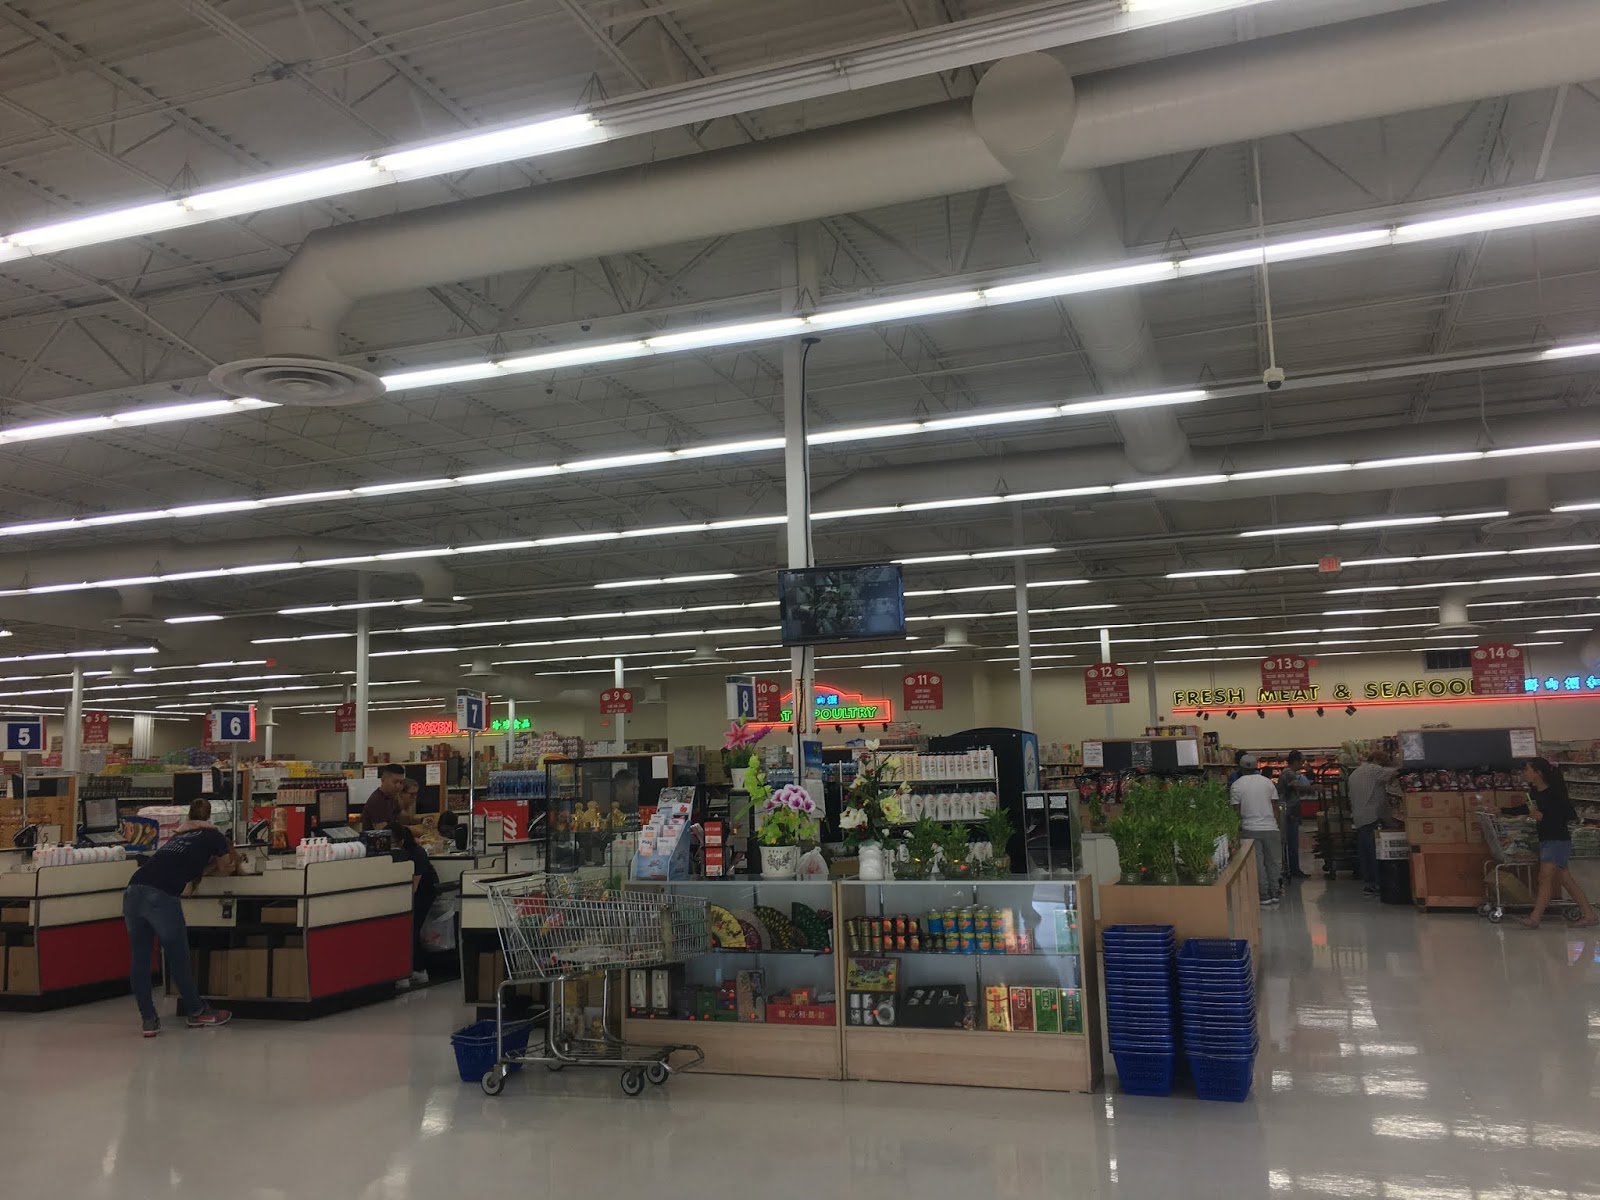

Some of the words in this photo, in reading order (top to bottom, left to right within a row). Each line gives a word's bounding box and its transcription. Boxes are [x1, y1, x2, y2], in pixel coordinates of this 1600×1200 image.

[1489, 647, 1505, 659] 14
[1277, 658, 1292, 669] 13
[1100, 666, 1113, 677] 12
[917, 674, 927, 685] 11
[757, 683, 768, 693] 10
[1173, 687, 1245, 706] FRESH
[1257, 684, 1321, 704] MEAT
[1333, 683, 1351, 700] &
[1364, 677, 1476, 699] SEAFOO
[613, 690, 620, 701] 9
[742, 690, 749, 711] 8
[347, 706, 353, 716] 7
[471, 704, 478, 723] 7
[815, 706, 877, 720] POULTRY
[94, 713, 100, 723] 5
[230, 716, 242, 736] 6
[410, 720, 453, 735] FROZEN
[18, 727, 31, 746] 5
